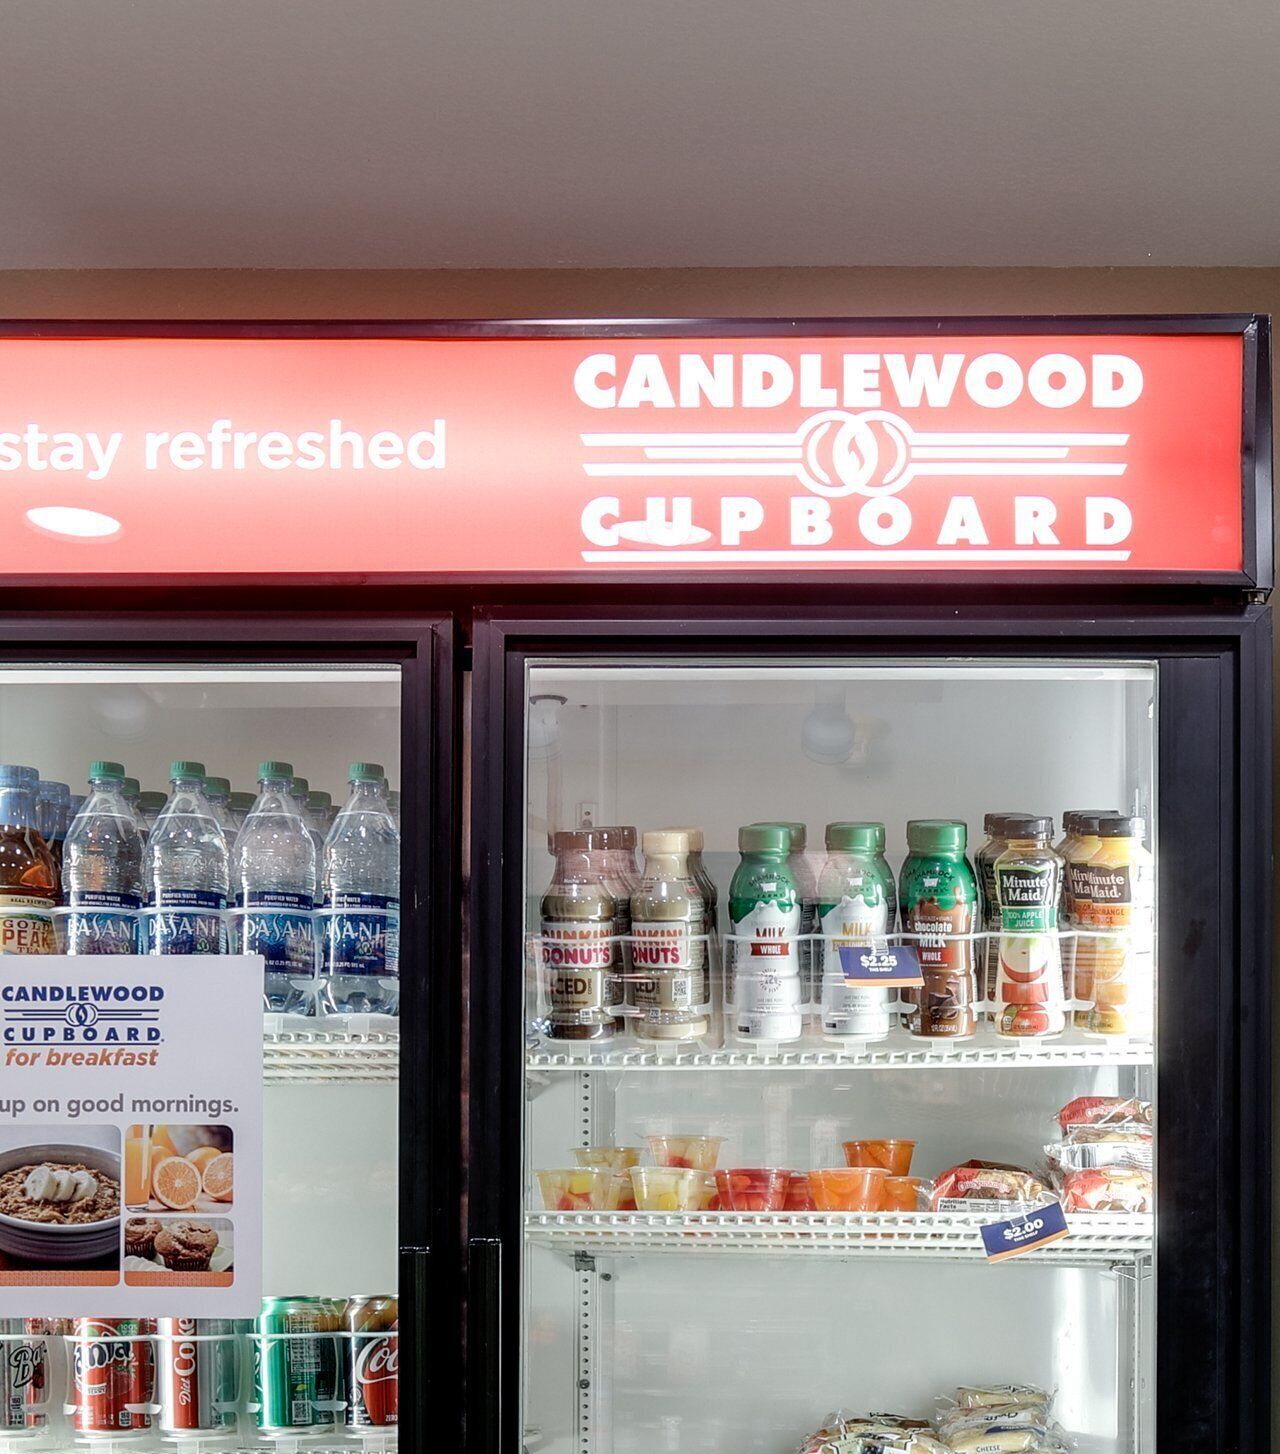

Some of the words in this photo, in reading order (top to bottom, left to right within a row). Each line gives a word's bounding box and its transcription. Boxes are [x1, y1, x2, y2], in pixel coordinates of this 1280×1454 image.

[573, 352, 1145, 410] CANDLEWOOD
[144, 418, 447, 470] refreshed
[581, 495, 1133, 547] CUPBOARD
[1003, 874, 1048, 888] Minute
[1008, 887, 1042, 902] Maid
[914, 921, 953, 933] chocolate
[2, 928, 50, 948] PEAK
[542, 947, 610, 965] DONUTS
[760, 944, 781, 955] WHOLE
[922, 951, 942, 961] WHOLE
[860, 954, 897, 968] $2.25
[1, 986, 165, 1002] CANDLEWOOD
[3, 1027, 161, 1042] CUPBOARD
[5, 1048, 41, 1067] for
[45, 1048, 159, 1067] breakfast
[33, 1098, 60, 1113] on
[67, 1093, 124, 1118] good
[131, 1094, 239, 1118] mornings.
[1003, 1218, 1044, 1240] $2.00
[178, 1378, 191, 1405] Diet
[976, 1444, 1001, 1453] CHEESE
